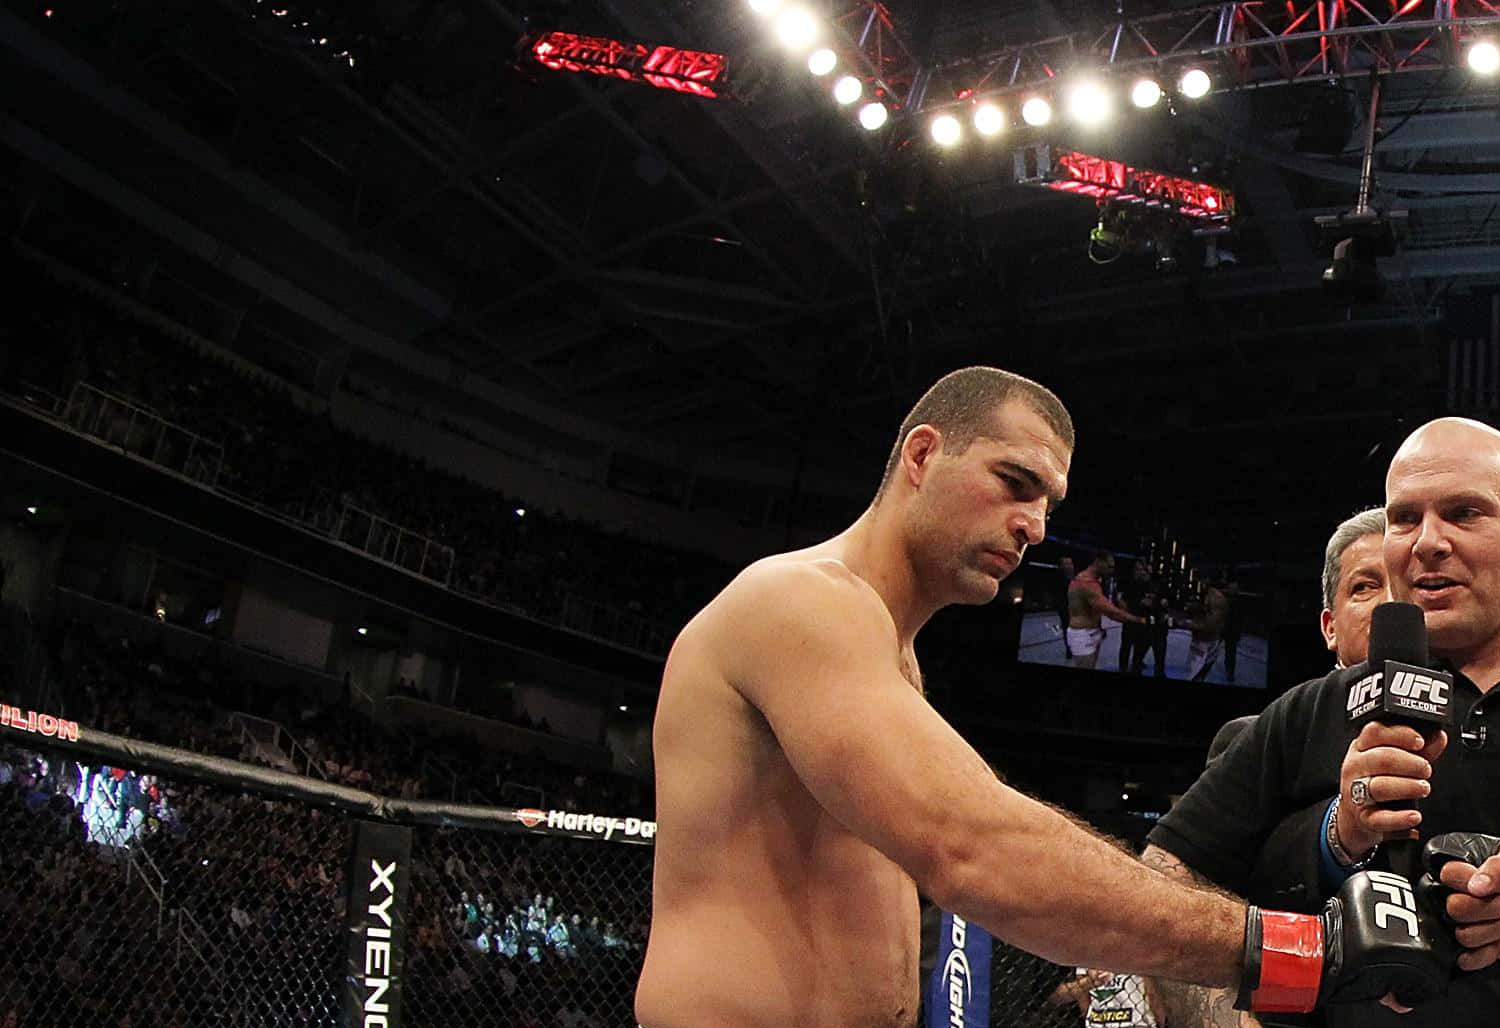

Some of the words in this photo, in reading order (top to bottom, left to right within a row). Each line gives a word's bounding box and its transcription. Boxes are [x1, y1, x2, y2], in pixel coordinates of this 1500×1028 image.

[1347, 673, 1383, 711] UFC
[1390, 672, 1449, 704] UFC
[1400, 698, 1437, 712] UFC.COM
[0, 704, 79, 742] ILION
[547, 810, 657, 840] Harley-Da
